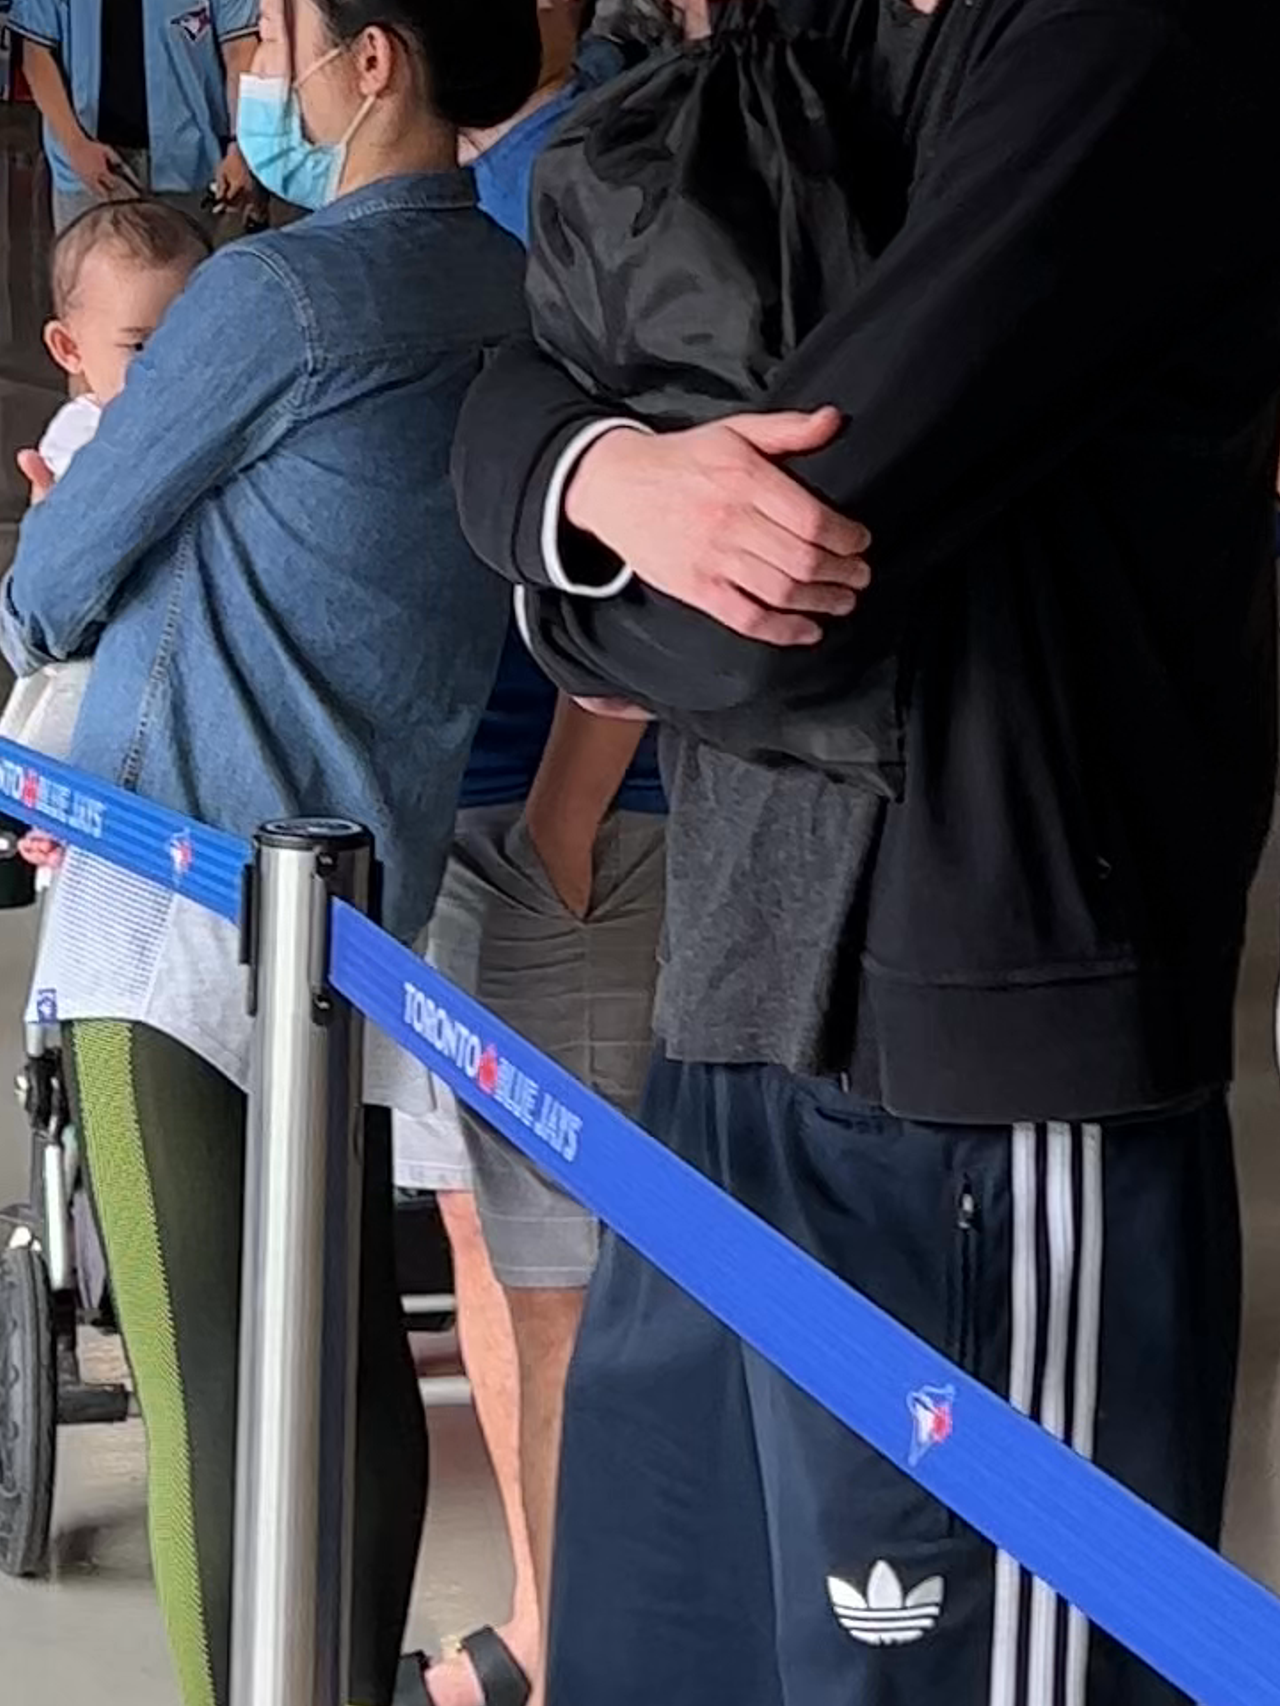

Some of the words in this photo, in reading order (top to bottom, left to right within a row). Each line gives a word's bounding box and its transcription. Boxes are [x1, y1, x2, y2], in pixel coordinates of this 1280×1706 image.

[404, 981, 482, 1078] TORONTO
[493, 1056, 539, 1127] BLUE
[532, 1092, 584, 1163] JAYS
